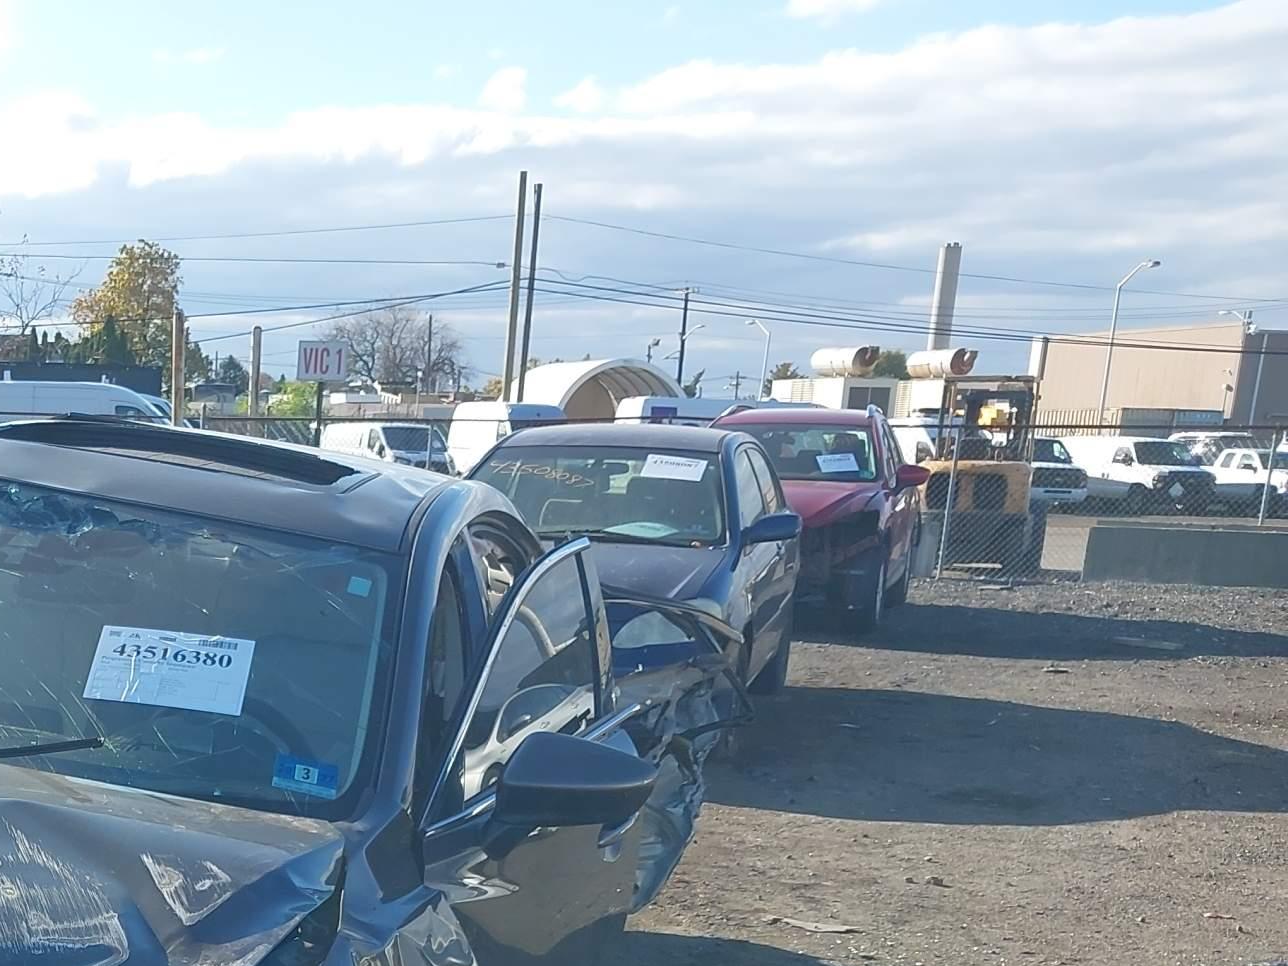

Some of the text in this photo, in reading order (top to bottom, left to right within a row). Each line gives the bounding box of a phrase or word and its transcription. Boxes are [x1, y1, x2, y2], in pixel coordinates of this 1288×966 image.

[303, 347, 343, 375] VIC 1
[112, 642, 233, 669] 43516380
[301, 767, 311, 780] 3
